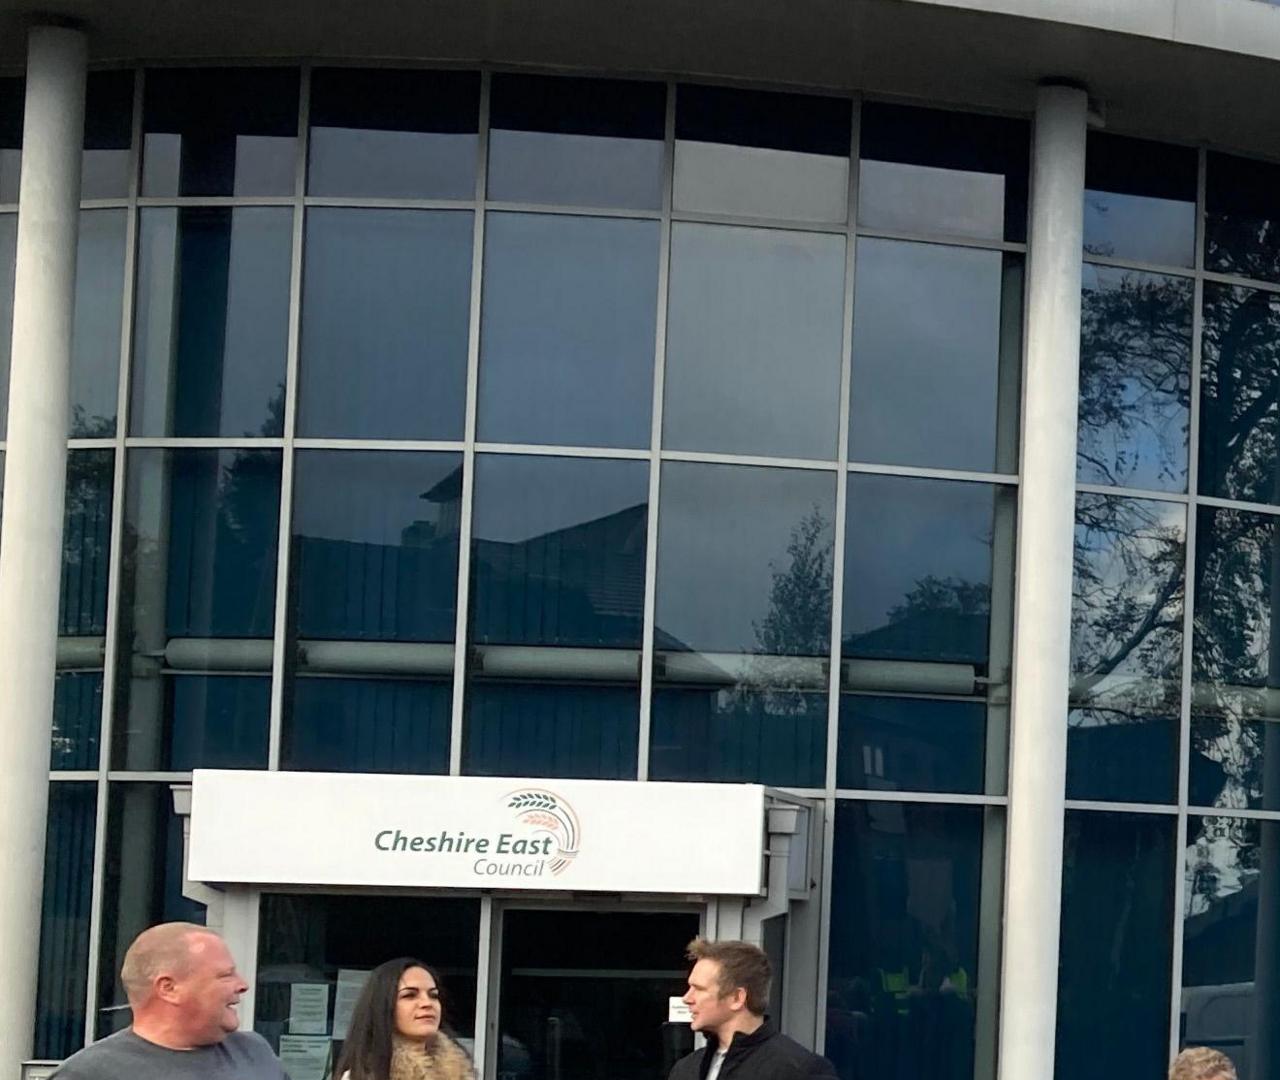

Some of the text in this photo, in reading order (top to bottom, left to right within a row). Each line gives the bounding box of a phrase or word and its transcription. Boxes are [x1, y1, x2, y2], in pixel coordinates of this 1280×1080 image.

[374, 830, 553, 855] Cheshire East
[473, 858, 545, 877] Council
